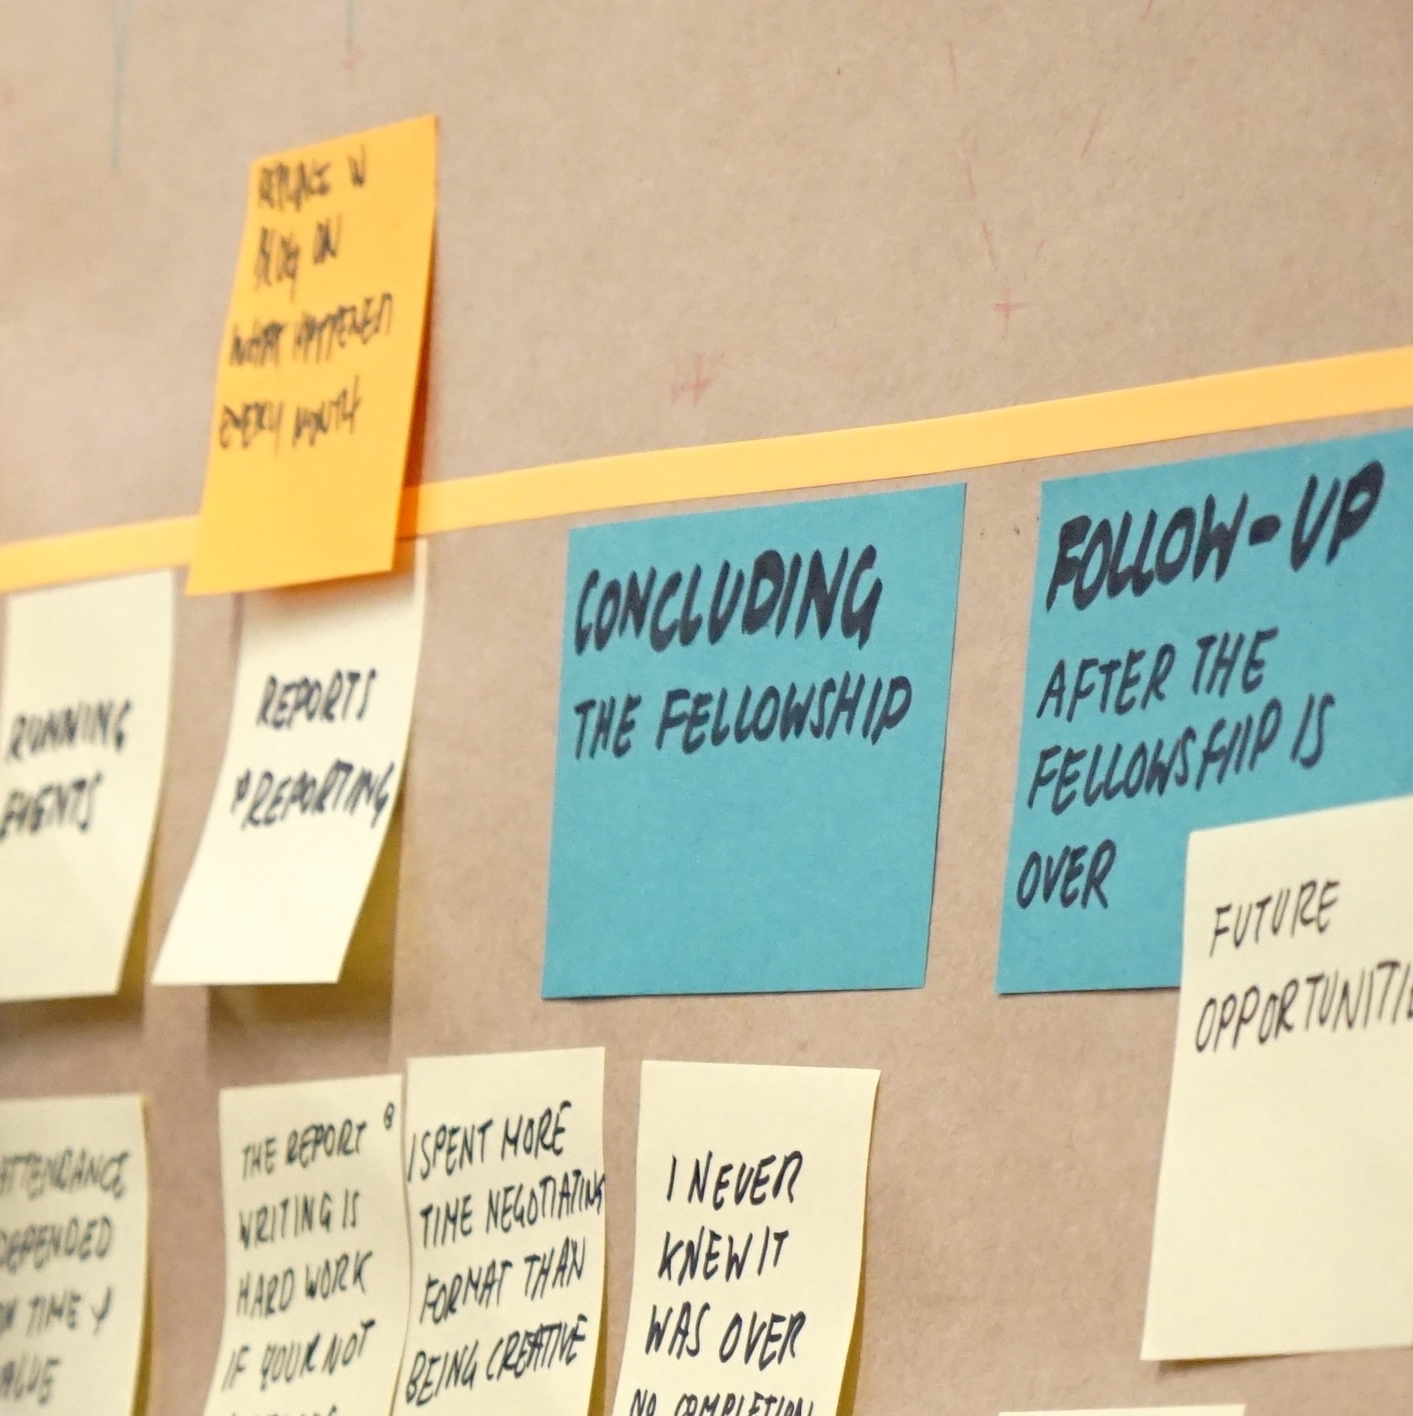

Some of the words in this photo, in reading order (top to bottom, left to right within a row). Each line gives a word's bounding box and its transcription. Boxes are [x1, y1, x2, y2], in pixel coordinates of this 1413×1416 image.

[1046, 459, 1386, 613] FOLLOW-UP
[573, 544, 883, 657] CONCLUDING
[256, 667, 376, 729] REPORTS
[1037, 643, 1176, 722] AFTER
[1192, 625, 1279, 698] THE
[5, 698, 132, 763] RUNNING
[574, 693, 643, 761] THE
[655, 670, 913, 755] FELLOWSHIP
[1026, 714, 1281, 815] FELLOWSHIP
[1291, 692, 1336, 769] IS
[1016, 837, 1117, 910] OVER
[1209, 878, 1341, 958] FUTURE
[1195, 960, 1413, 1053] OPPORTUNITI
[242, 1138, 276, 1181] THE
[286, 1119, 369, 1170] REPORT
[419, 1117, 493, 1182] SPENT
[500, 1100, 573, 1160] MORE
[665, 1153, 677, 1203] I
[686, 1149, 804, 1211] NEVER
[238, 1191, 332, 1250] WRITING
[342, 1189, 360, 1229] IS
[419, 1192, 474, 1250] TIME
[656, 1224, 754, 1286] KNEW
[756, 1225, 791, 1277] IT
[26, 1289, 83, 1338] TIME
[236, 1268, 295, 1320] HARD
[304, 1250, 374, 1302] WORK
[419, 1259, 514, 1325] FORMAT
[523, 1236, 587, 1302] THAN
[222, 1344, 251, 1393] IF
[321, 1318, 376, 1376] NOT
[404, 1338, 479, 1408] BEING
[485, 1312, 588, 1382] CREATIVE
[643, 1300, 712, 1360] WAS
[717, 1310, 807, 1371] OVER
